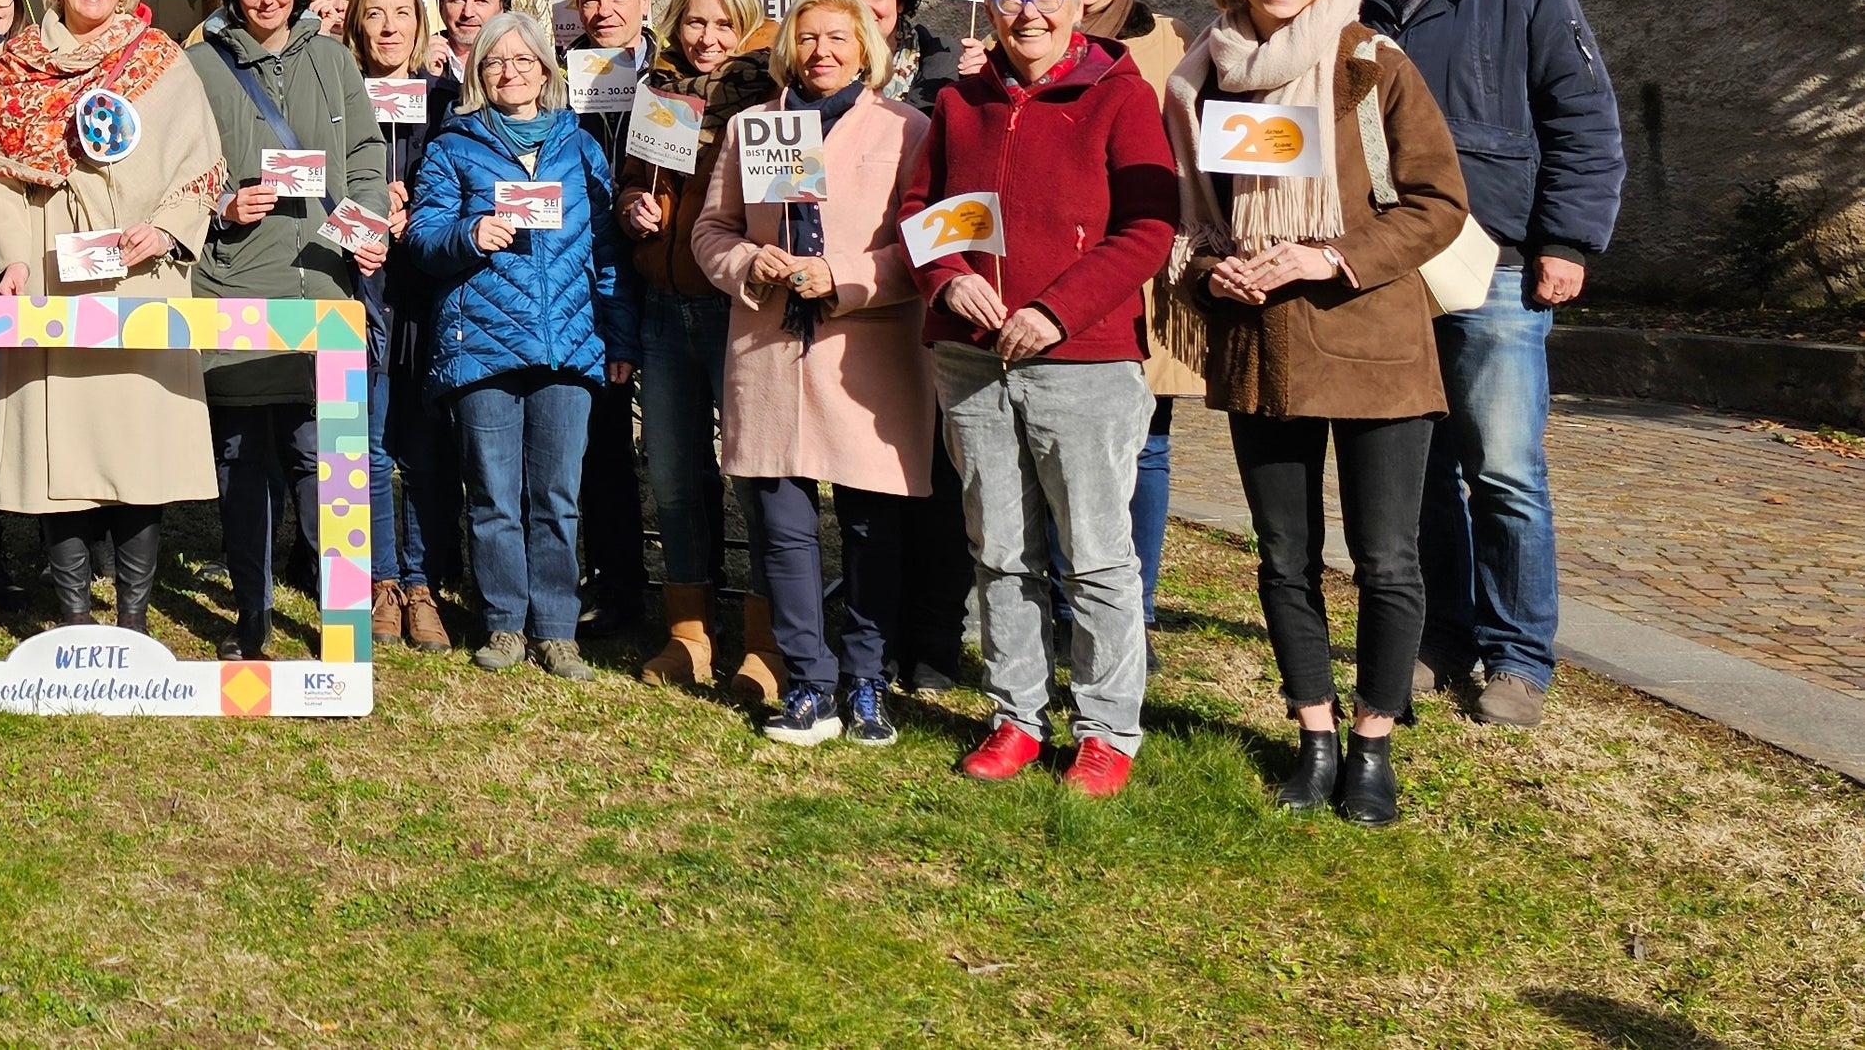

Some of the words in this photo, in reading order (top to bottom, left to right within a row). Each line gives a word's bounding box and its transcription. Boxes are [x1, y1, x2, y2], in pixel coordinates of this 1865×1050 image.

[582, 54, 614, 75] 20
[409, 94, 423, 102] SEI
[573, 88, 599, 96] 14.02
[608, 86, 635, 95] 30.03
[645, 101, 676, 128] 20
[744, 116, 802, 146] DU
[1220, 113, 1304, 164] 20
[631, 130, 656, 146] 14.02
[664, 142, 692, 156] 30.03
[745, 149, 766, 157] BIST
[766, 149, 803, 162] MIR
[308, 167, 322, 175] SEI
[748, 165, 805, 175] WICHTIG
[543, 199, 559, 207] SEI
[922, 200, 994, 250] 20
[55, 645, 130, 669] WERTE
[304, 673, 335, 689] KFS
